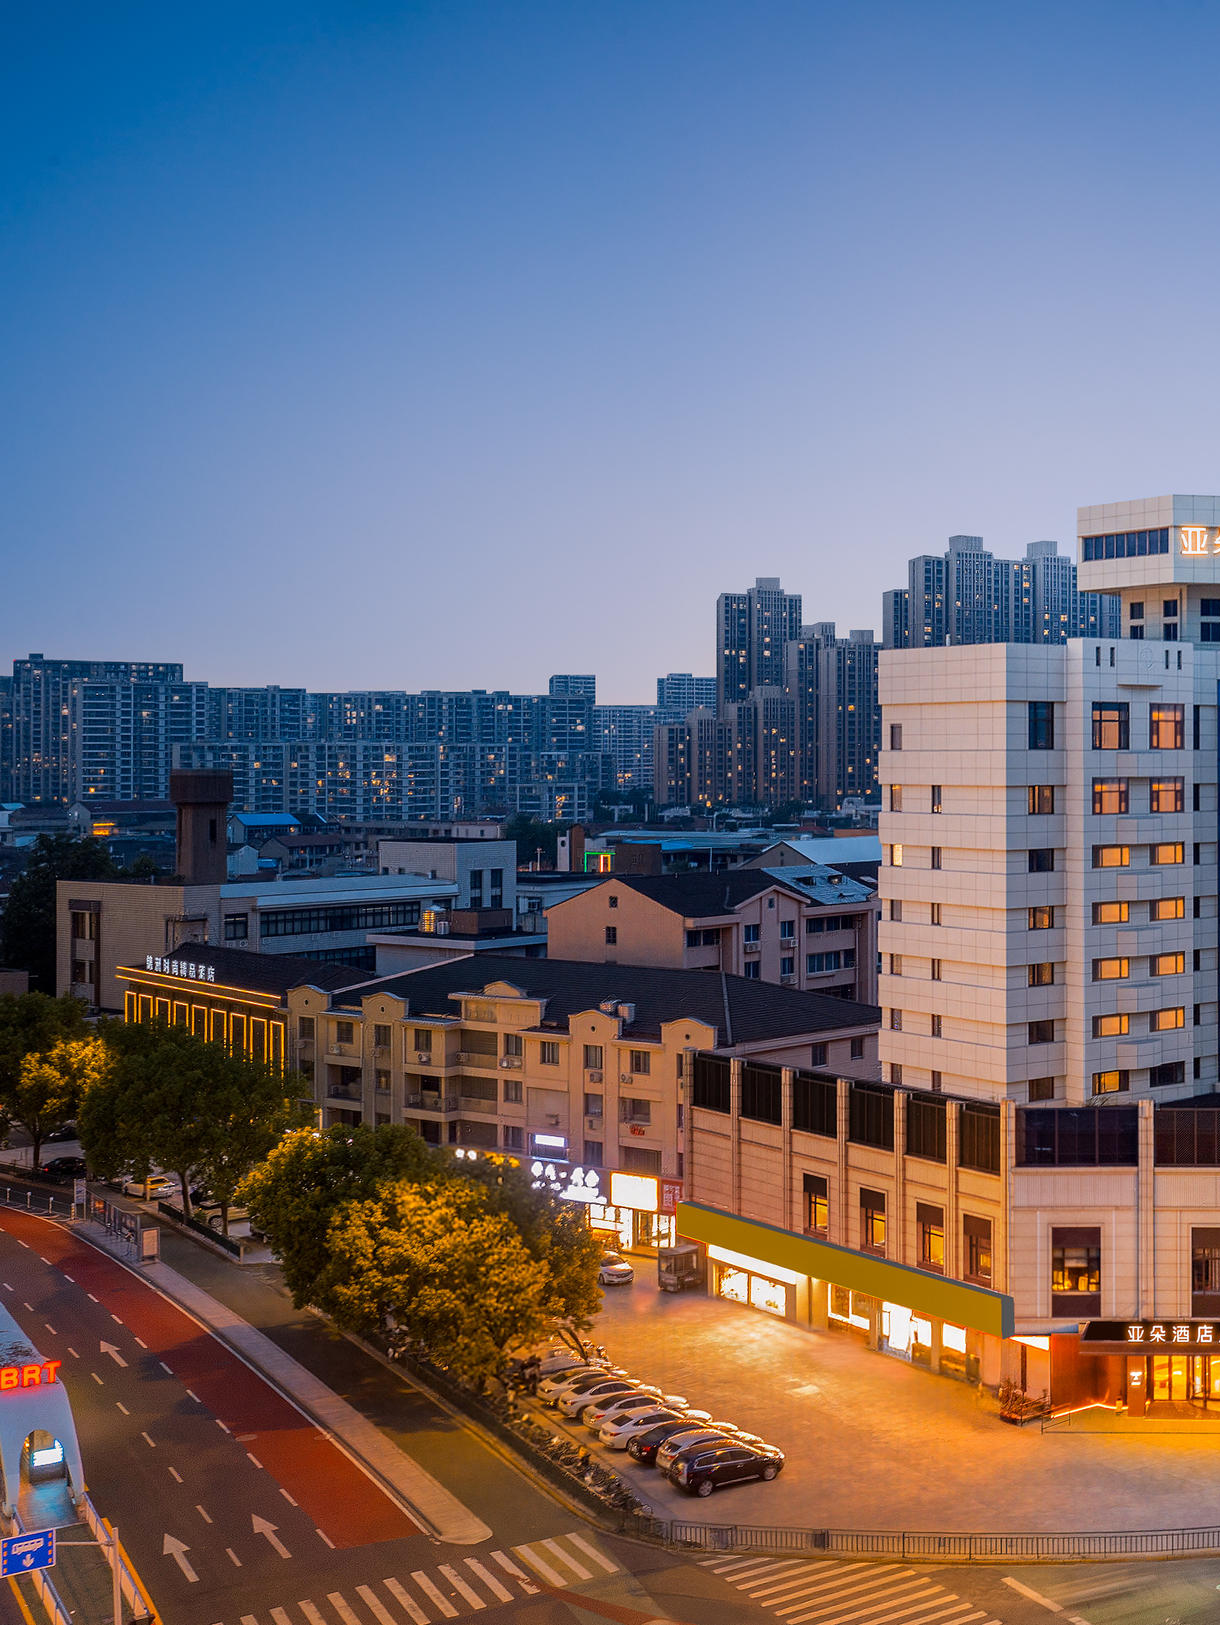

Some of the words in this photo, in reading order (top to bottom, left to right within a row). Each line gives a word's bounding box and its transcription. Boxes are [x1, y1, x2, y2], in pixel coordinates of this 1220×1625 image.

[1127, 1325, 1214, 1343] 亚朵酒店
[0, 1360, 62, 1390] BRT
